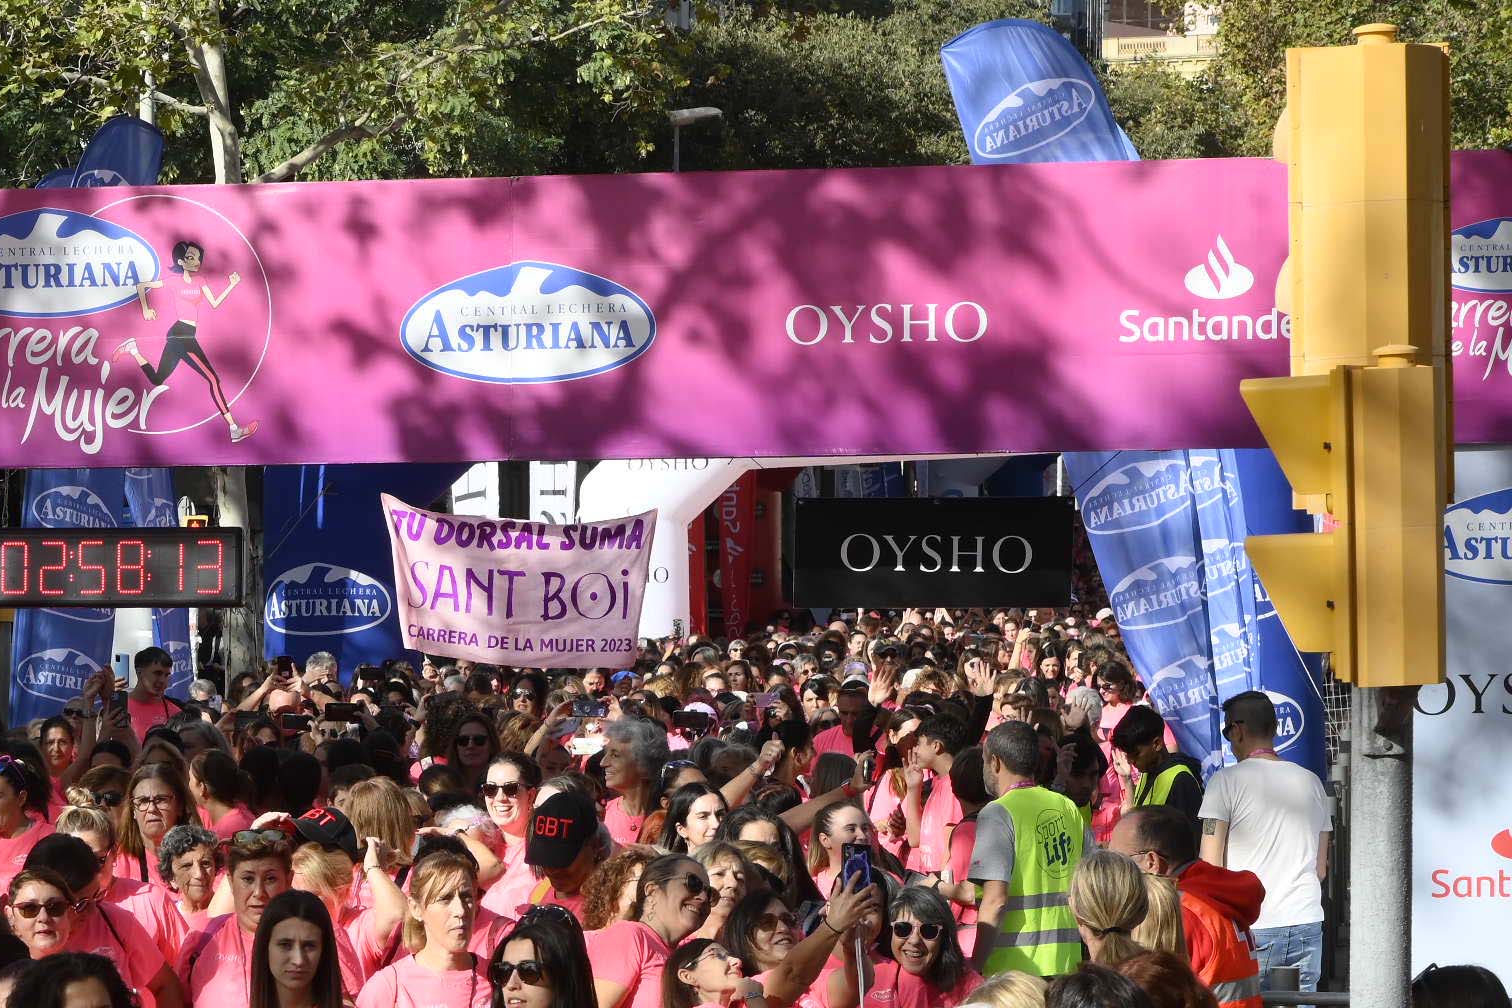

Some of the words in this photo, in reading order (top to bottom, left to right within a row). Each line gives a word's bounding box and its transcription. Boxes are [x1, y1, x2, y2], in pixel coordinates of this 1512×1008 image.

[421, 309, 636, 353] ASTURIANA
[460, 304, 538, 318] CENTRAL
[547, 303, 627, 315] LECHERA
[785, 301, 988, 346] OYSHO
[1119, 307, 1292, 343] Santande
[1, 367, 26, 408] la
[21, 361, 170, 454] Mujer
[391, 509, 428, 542] TU
[433, 521, 551, 552] DORSAL
[560, 519, 643, 551] SUMA
[0, 539, 224, 595] 02:58:13
[840, 533, 1033, 574] OYSHO
[269, 590, 381, 619] ASTURIANA
[408, 560, 526, 619] SANT
[407, 623, 479, 647] CARRERA
[487, 634, 509, 650] DE
[514, 637, 534, 652] LA
[539, 638, 595, 653] MUJER
[600, 638, 632, 653] 2023
[23, 664, 87, 692] ASTURI
